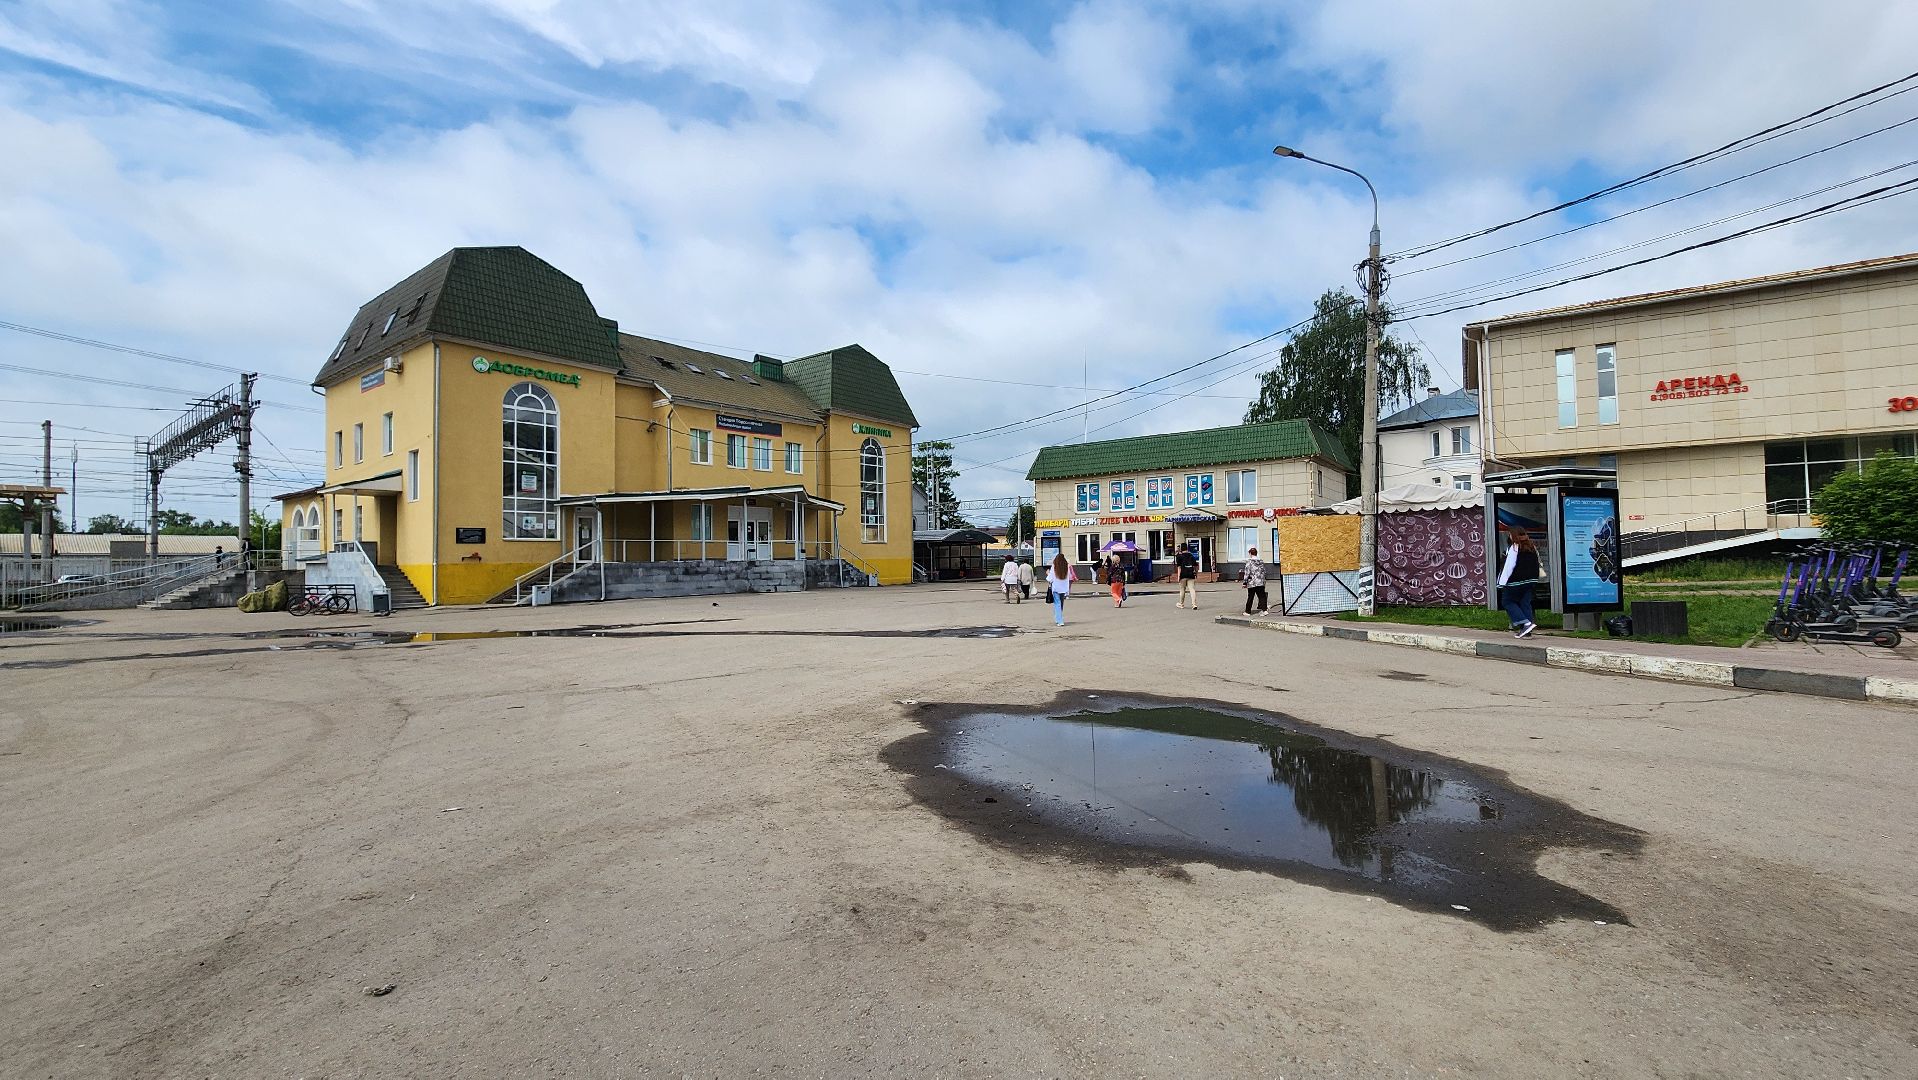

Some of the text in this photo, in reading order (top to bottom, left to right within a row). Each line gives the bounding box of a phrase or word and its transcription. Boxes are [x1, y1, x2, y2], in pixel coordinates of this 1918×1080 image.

[488, 361, 581, 388] ДОБРОМЕД
[1655, 373, 1742, 393] АРЕНДА
[1688, 389, 1710, 398] 503
[1716, 387, 1729, 395] 73
[1734, 385, 1749, 393] 53
[1034, 519, 1069, 528] ЛОМБАРД
[1071, 517, 1098, 527] ТАБАК
[1099, 516, 1121, 526] ХЛЕБ
